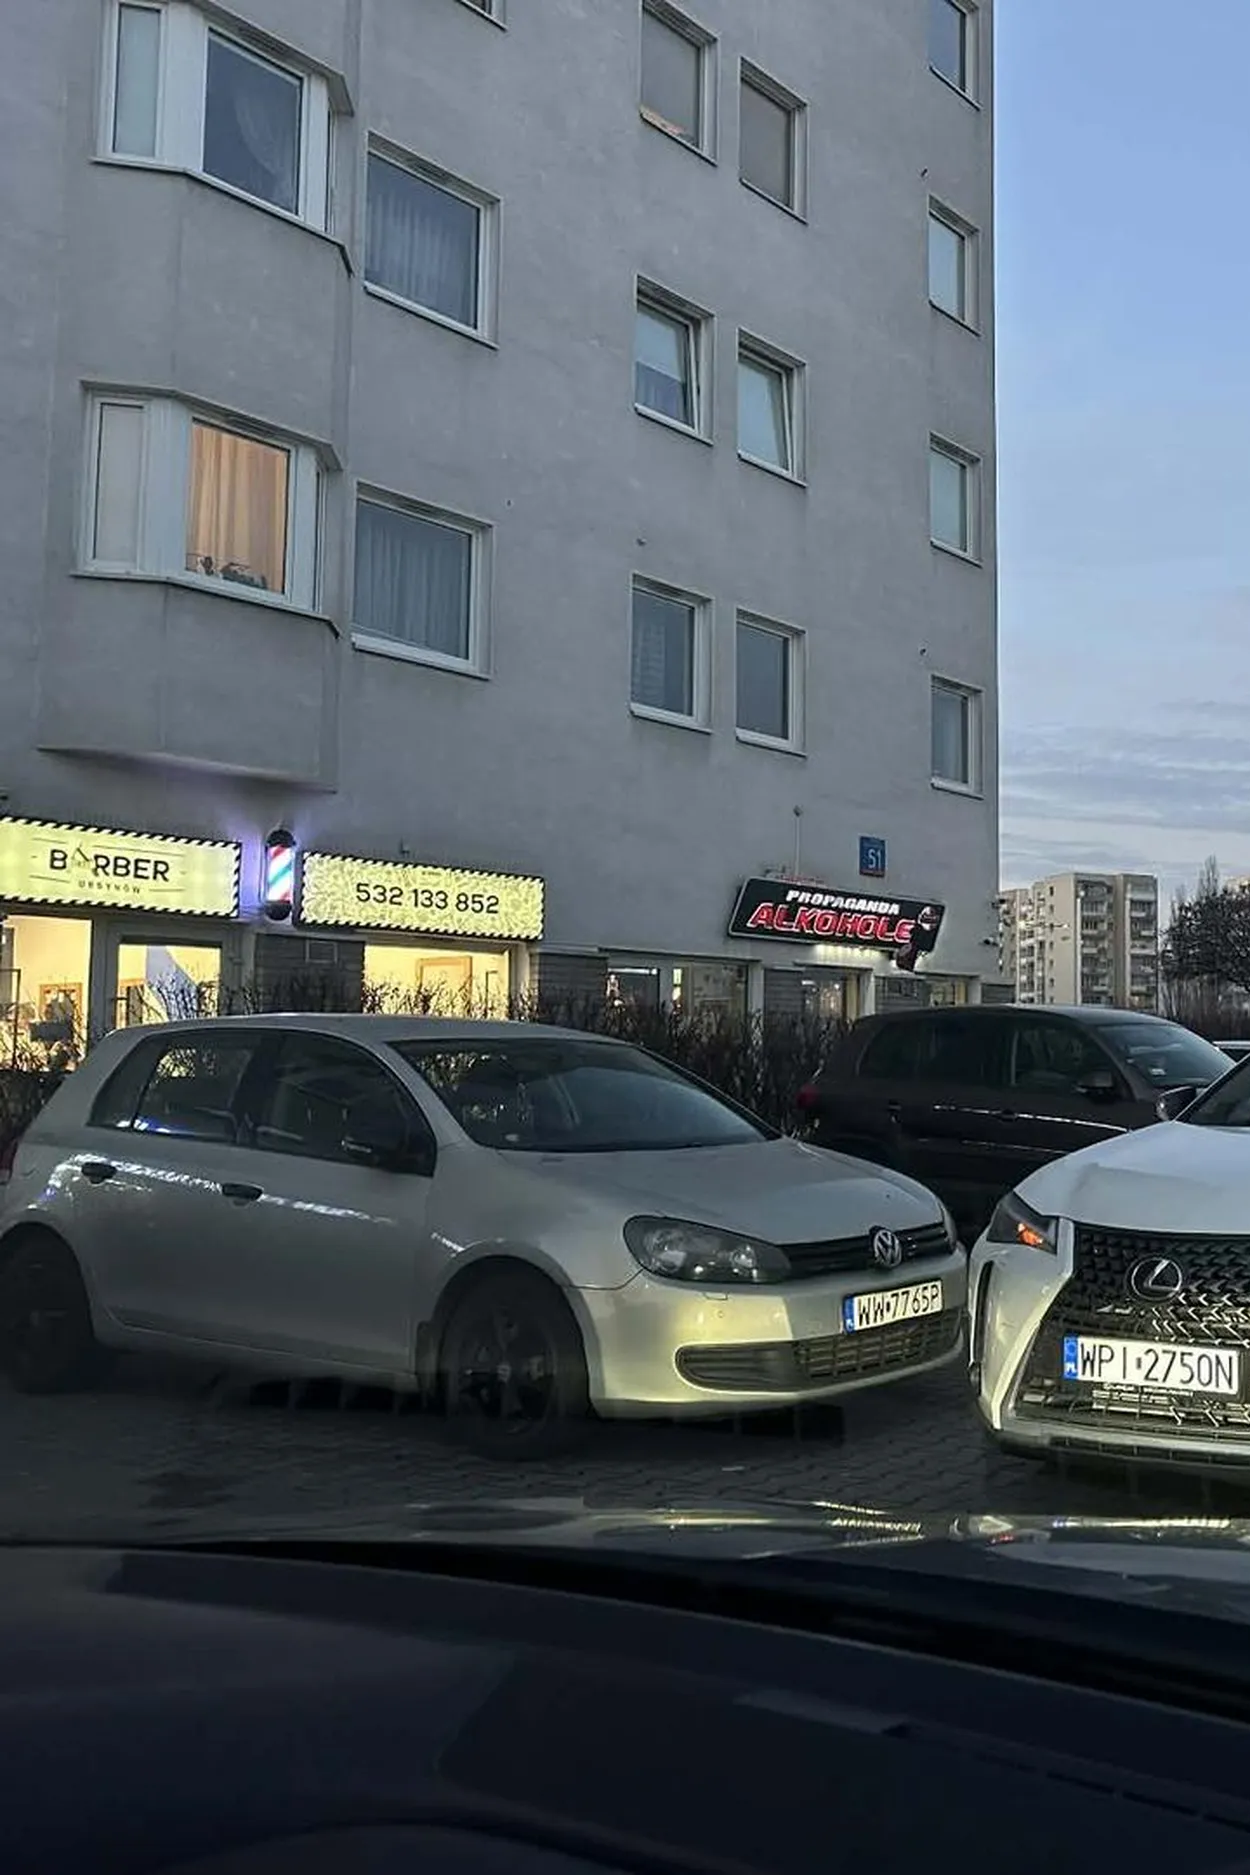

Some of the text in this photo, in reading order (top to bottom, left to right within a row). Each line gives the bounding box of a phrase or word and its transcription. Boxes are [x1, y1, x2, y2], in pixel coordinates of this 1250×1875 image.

[868, 848, 882, 869] 51
[356, 882, 500, 914] 532 133 852
[785, 889, 900, 916] PROPAGANDA
[747, 901, 917, 944] ALKOHOLE
[1081, 1342, 1234, 1390] WPI 2750N
